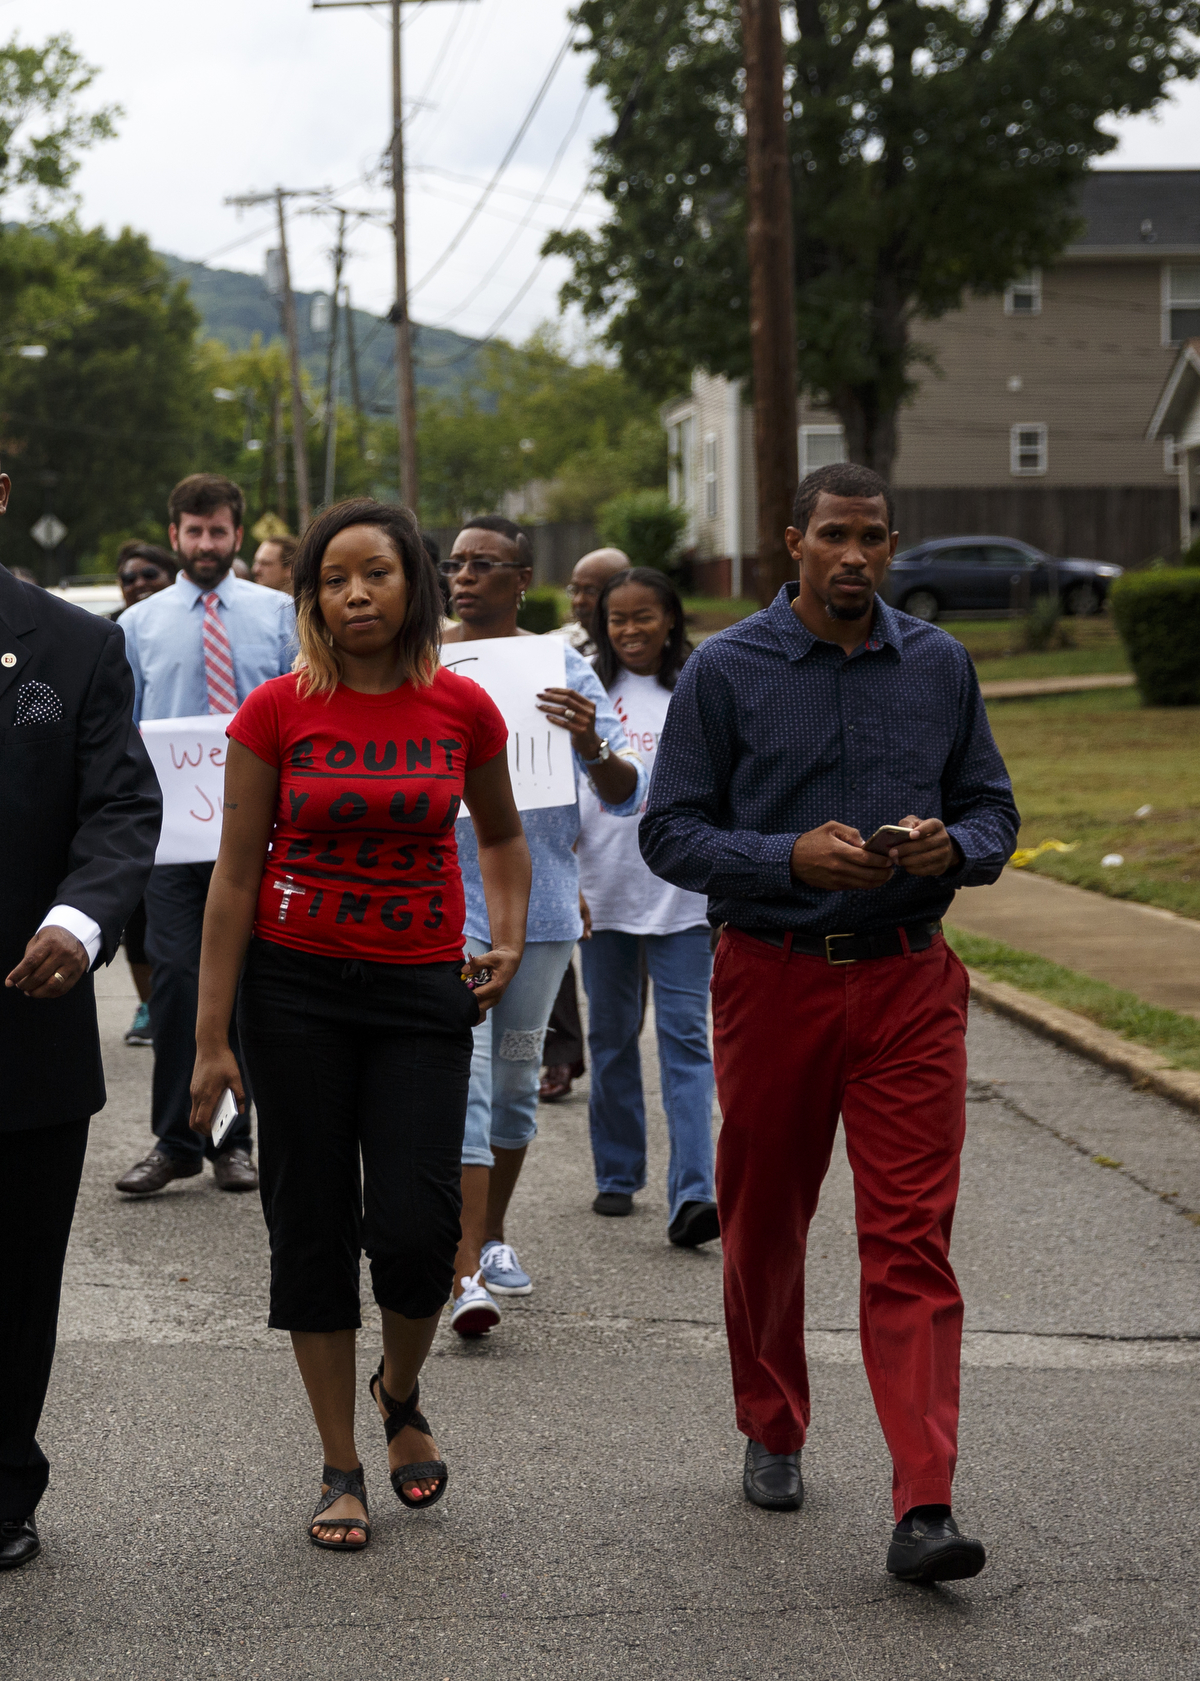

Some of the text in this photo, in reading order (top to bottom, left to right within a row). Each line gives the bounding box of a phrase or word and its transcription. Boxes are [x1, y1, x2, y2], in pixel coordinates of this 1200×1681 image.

[169, 742, 226, 770] We
[290, 737, 462, 771] COUNT
[288, 788, 462, 830] YOUR
[284, 837, 446, 872] BLESS
